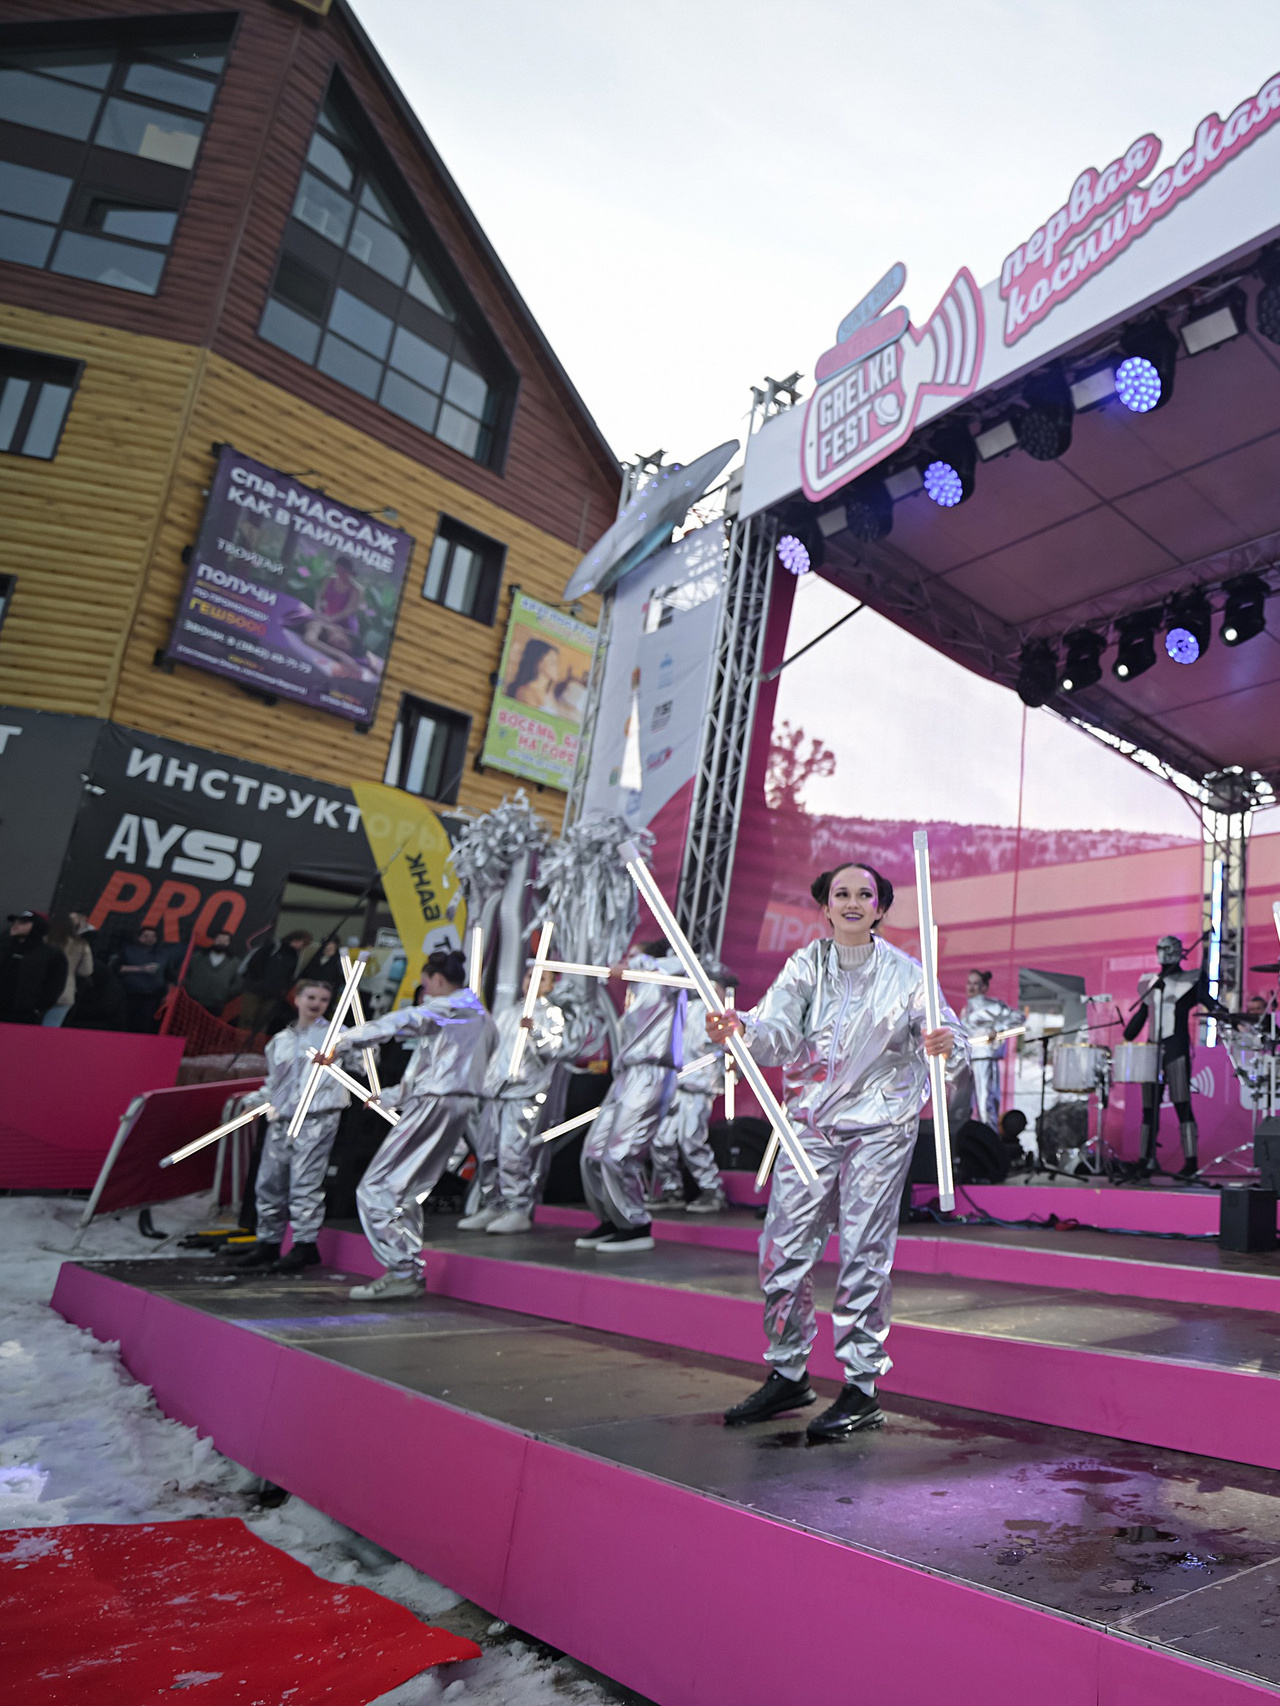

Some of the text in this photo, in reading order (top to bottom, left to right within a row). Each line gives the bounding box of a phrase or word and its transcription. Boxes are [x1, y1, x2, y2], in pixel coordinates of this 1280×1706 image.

[1002, 139, 1153, 289] первая
[820, 344, 898, 434] GRELKA
[819, 403, 872, 473] FEST
[227, 485, 395, 574] КАК В ТАИЛАНДЕ
[196, 562, 278, 607] ПОЛУЧИ
[104, 812, 263, 888] AYS!
[86, 869, 247, 949] PRO
